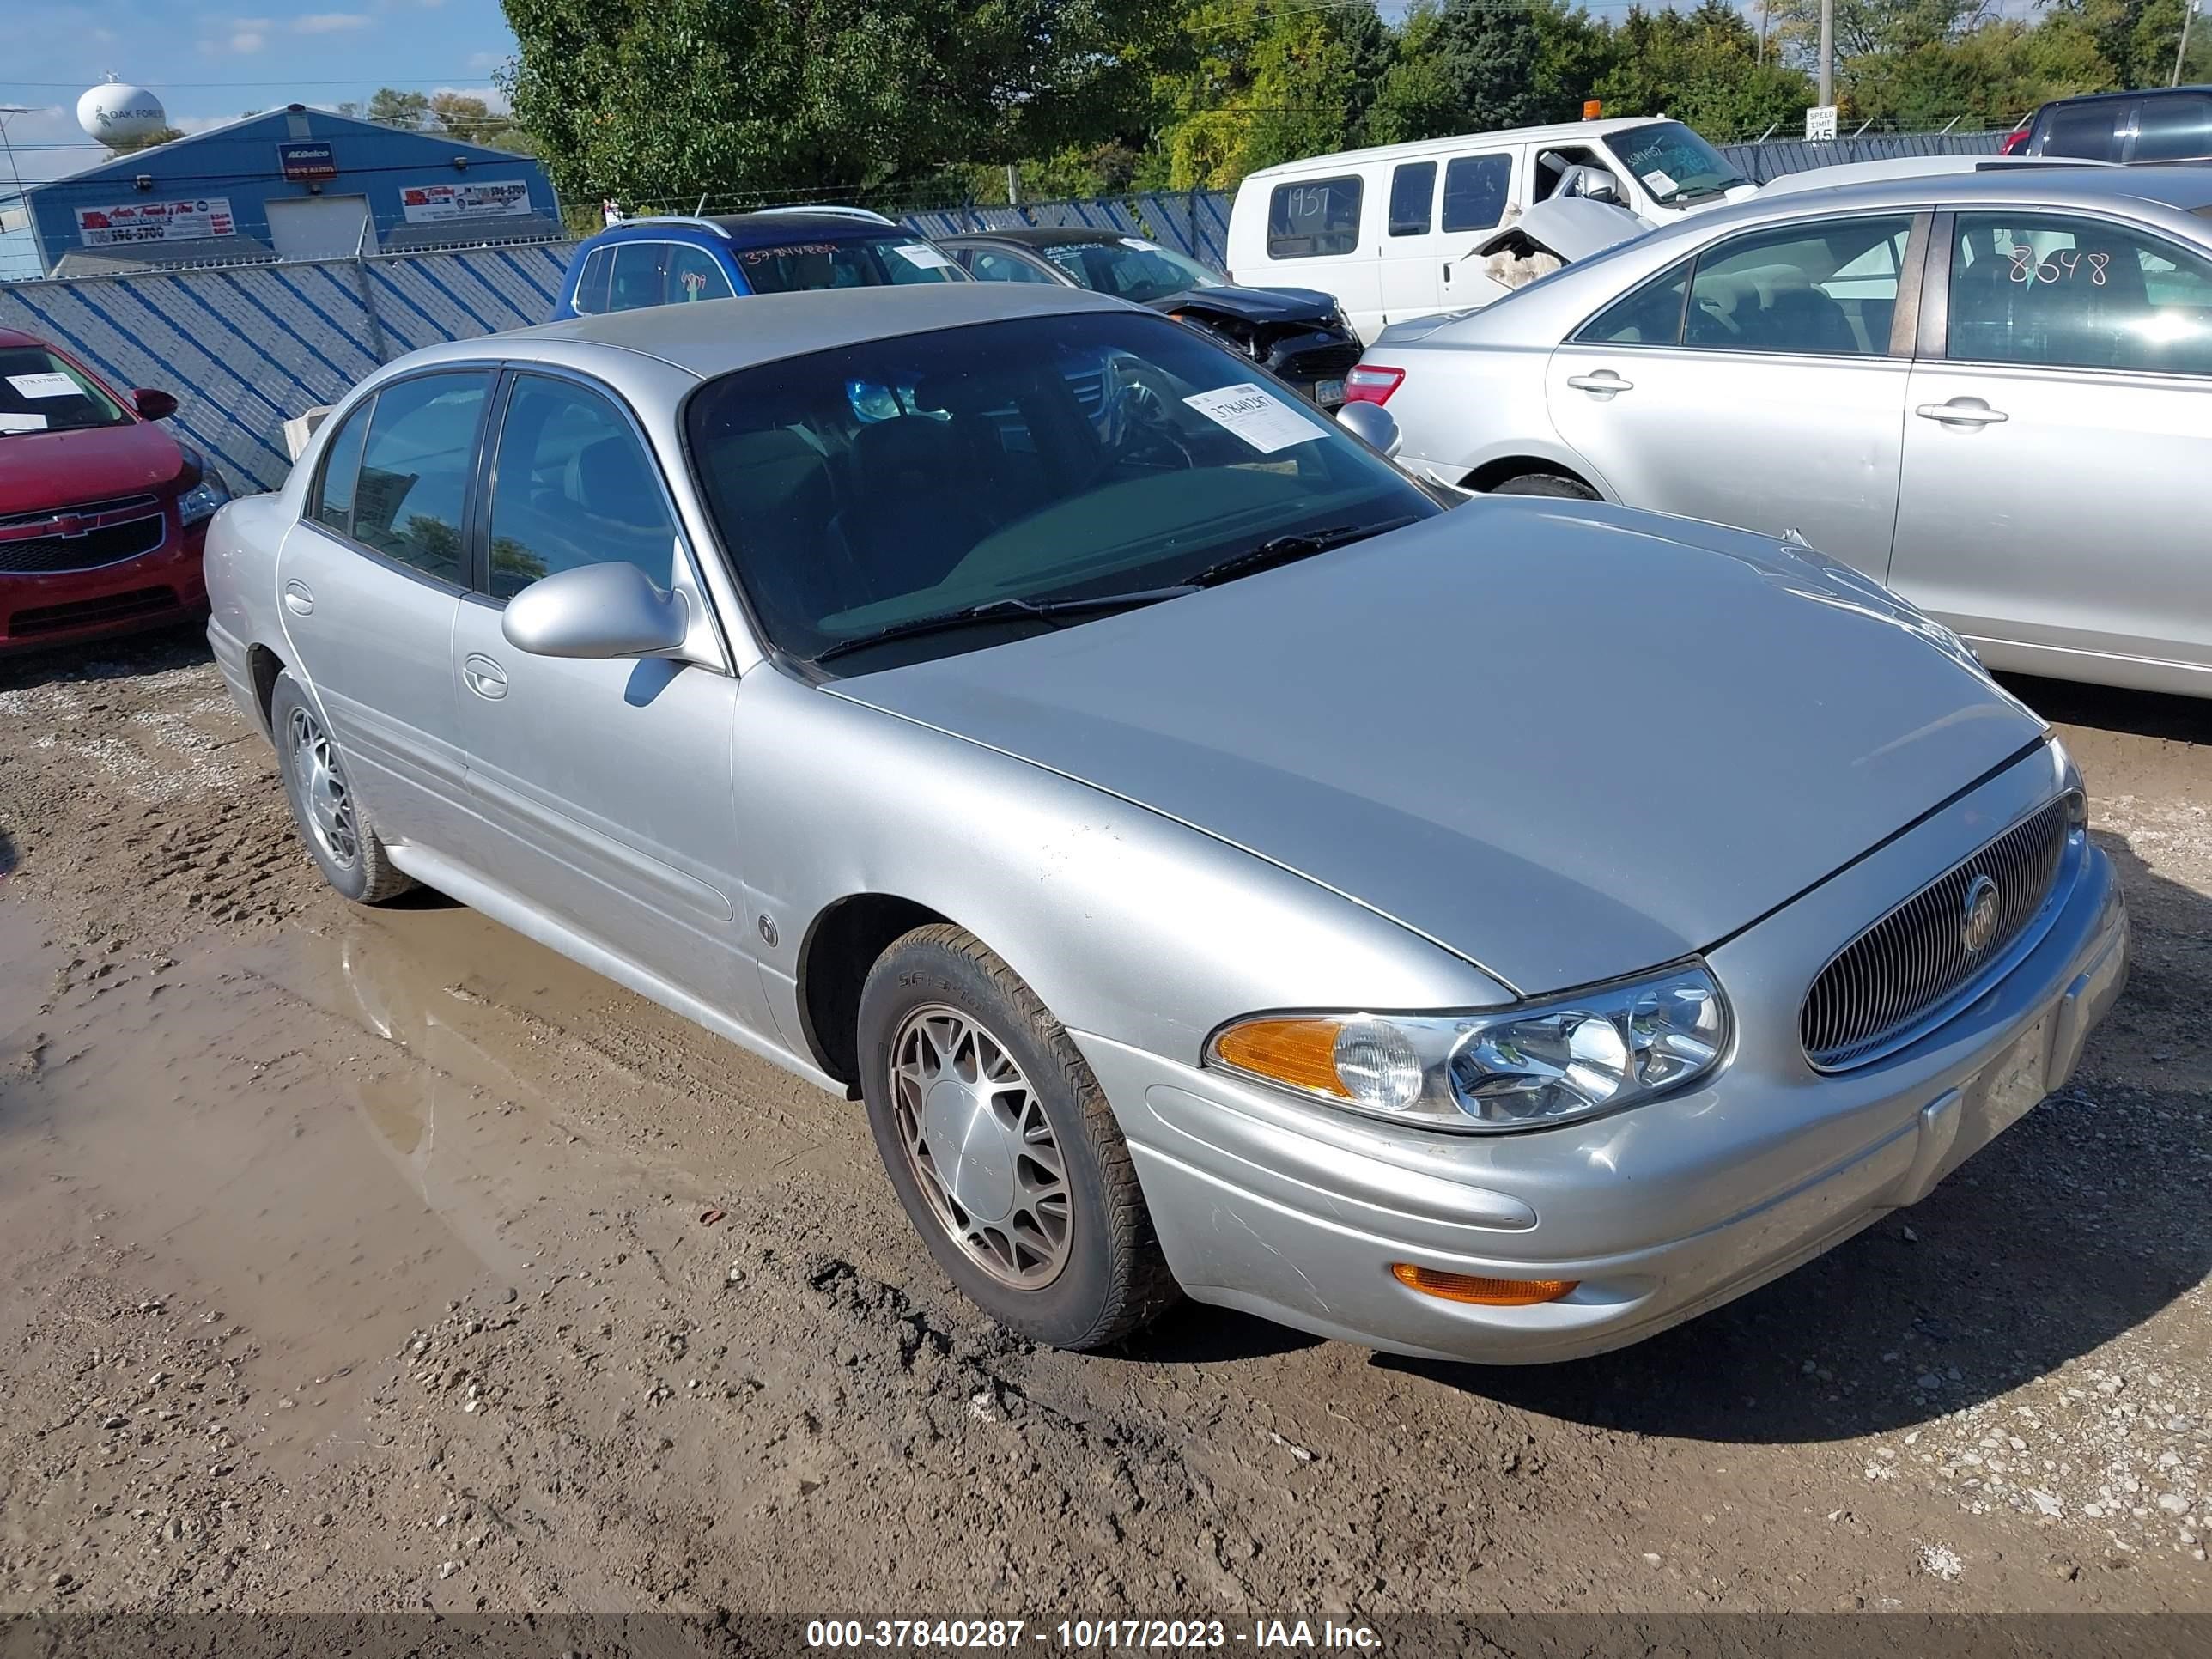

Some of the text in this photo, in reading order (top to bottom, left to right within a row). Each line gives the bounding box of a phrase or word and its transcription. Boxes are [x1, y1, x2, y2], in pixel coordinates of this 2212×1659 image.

[110, 110, 133, 119] OAK
[1809, 110, 1834, 120] SPEED
[1811, 119, 1831, 128] LIMIT
[1810, 129, 1832, 141] 45
[288, 149, 330, 159] ACDelco
[1287, 186, 1330, 219] 1957
[1210, 395, 1273, 418] 37840287
